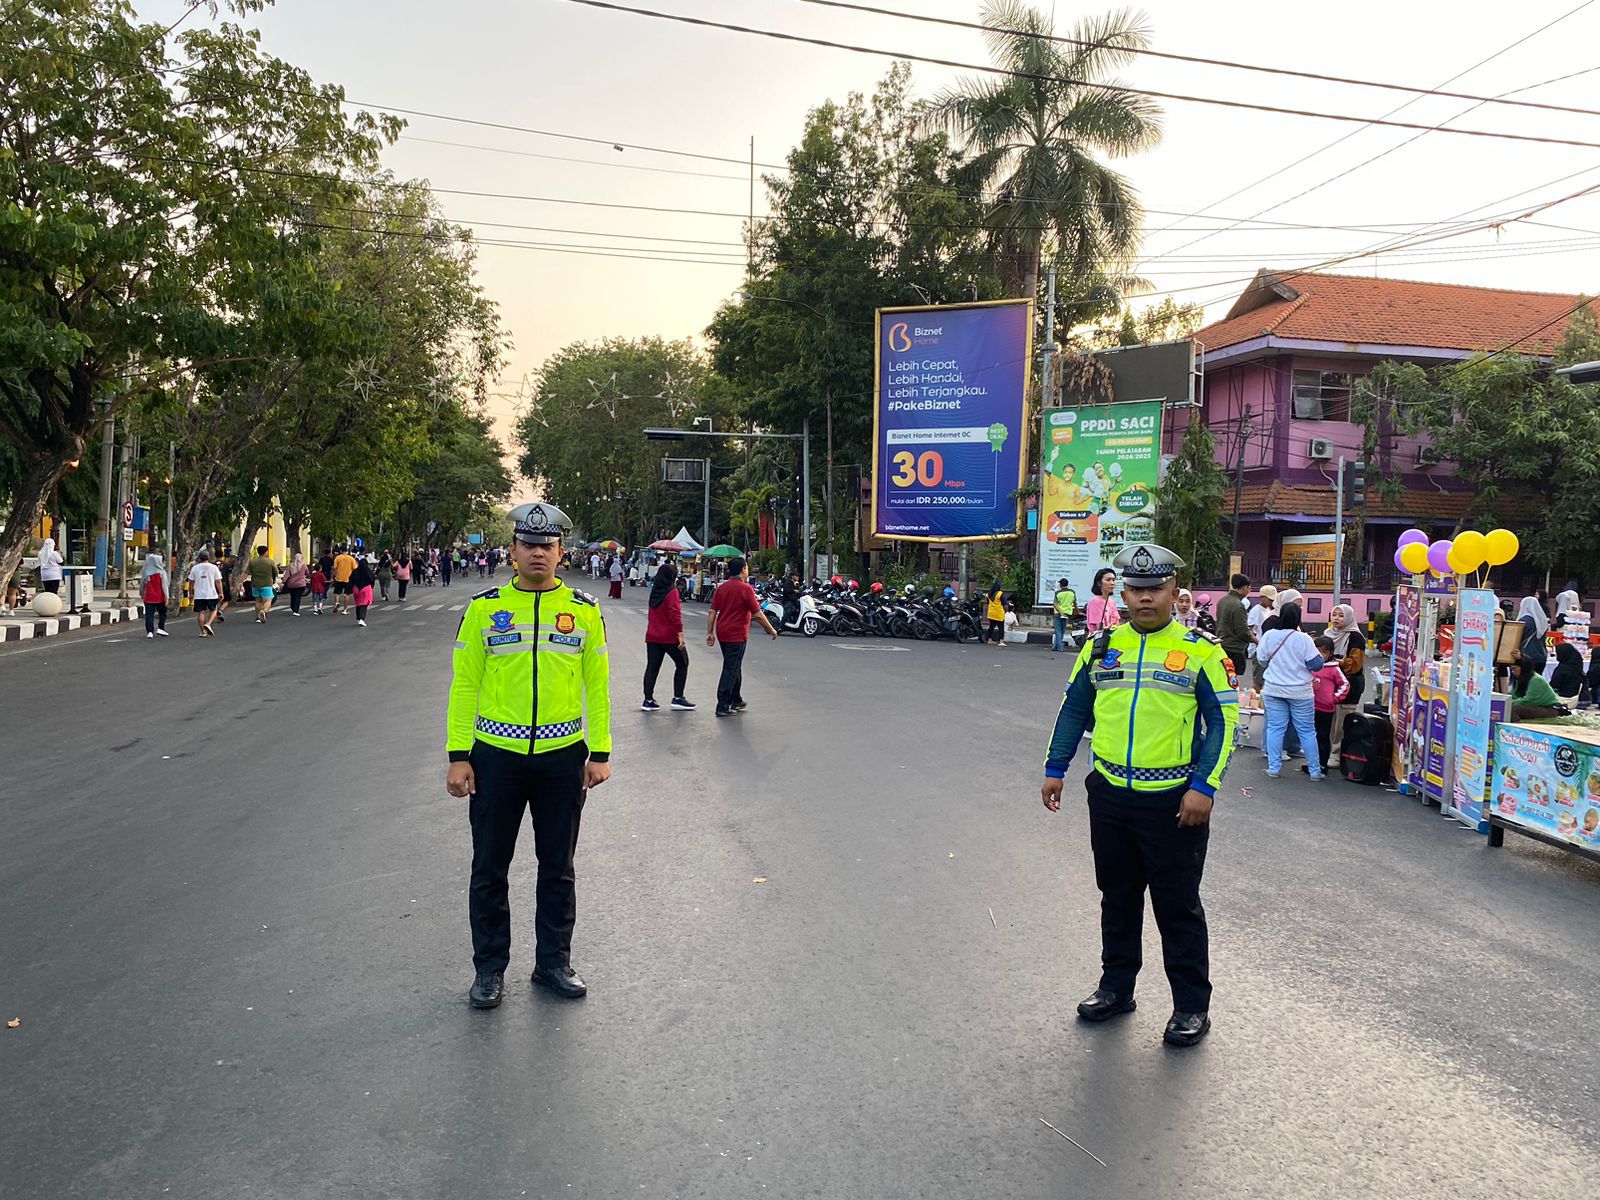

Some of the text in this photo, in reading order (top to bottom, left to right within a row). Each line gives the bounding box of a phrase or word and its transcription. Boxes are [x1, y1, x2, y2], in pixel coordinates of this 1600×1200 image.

[914, 327, 943, 337] Biznet
[914, 337, 939, 345] Home
[888, 359, 959, 372] Lebih Cepat,
[888, 372, 965, 385] Lebih Handal,
[888, 385, 988, 398] Lebih Terjangkau.
[888, 399, 961, 411] #PakeBiznet
[1080, 416, 1155, 432] PPDB SACI
[891, 450, 966, 488] 30 Mbps
[916, 496, 931, 504] IDR
[491, 633, 518, 645] GUNTUR
[554, 634, 579, 646] POLRI
[1156, 672, 1188, 686] POLRI
